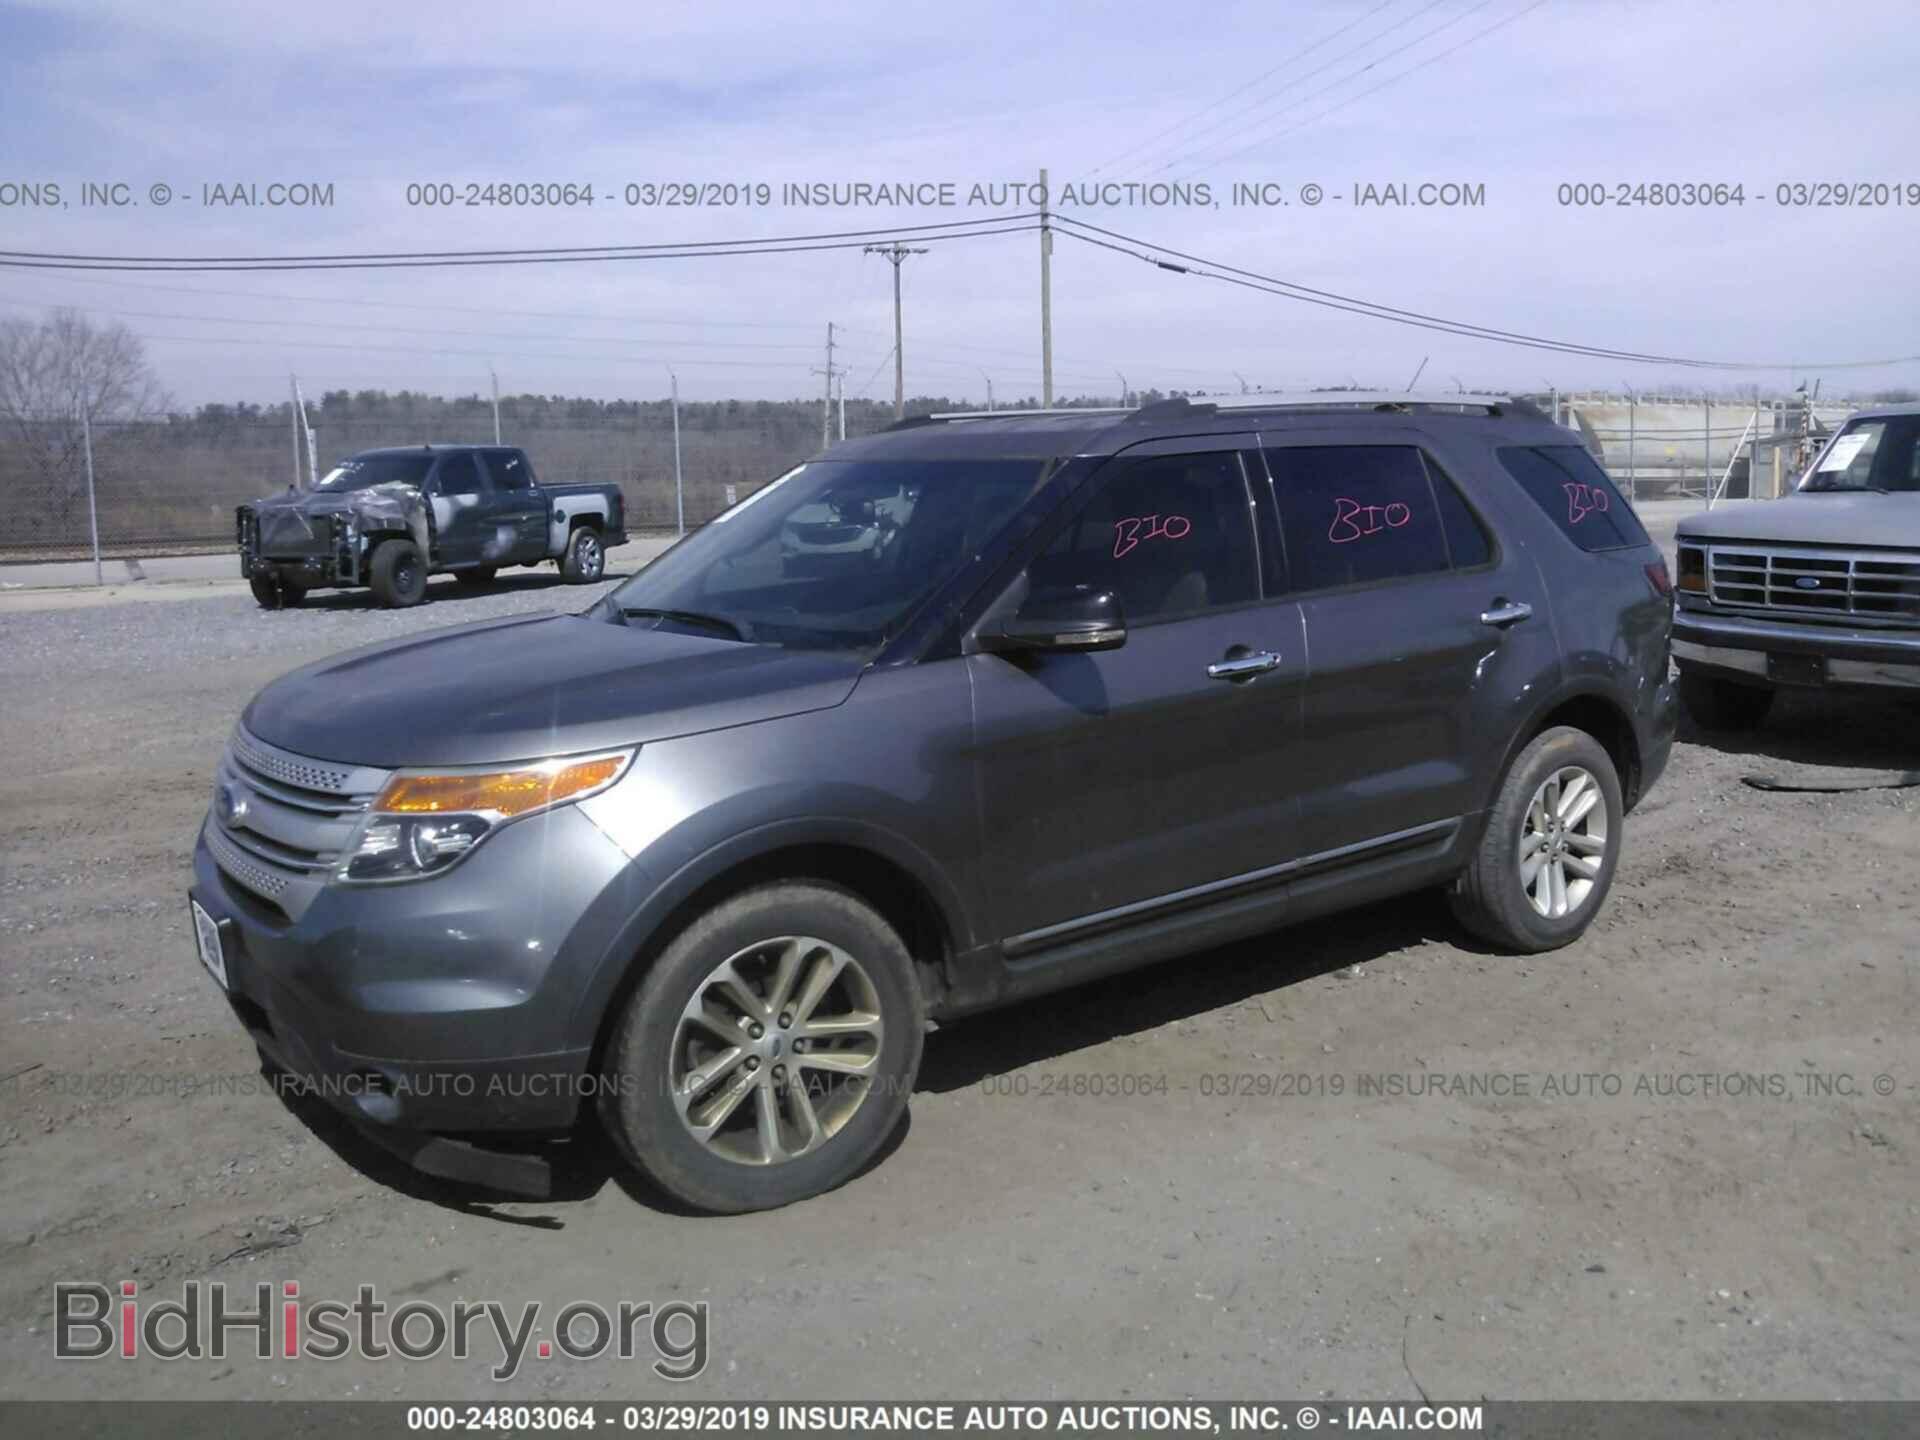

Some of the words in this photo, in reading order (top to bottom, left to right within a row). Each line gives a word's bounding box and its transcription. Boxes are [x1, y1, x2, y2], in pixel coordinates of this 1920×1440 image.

[1328, 498, 1409, 542] BIO
[1562, 483, 1608, 523] BIO
[1114, 515, 1190, 558] BIO
